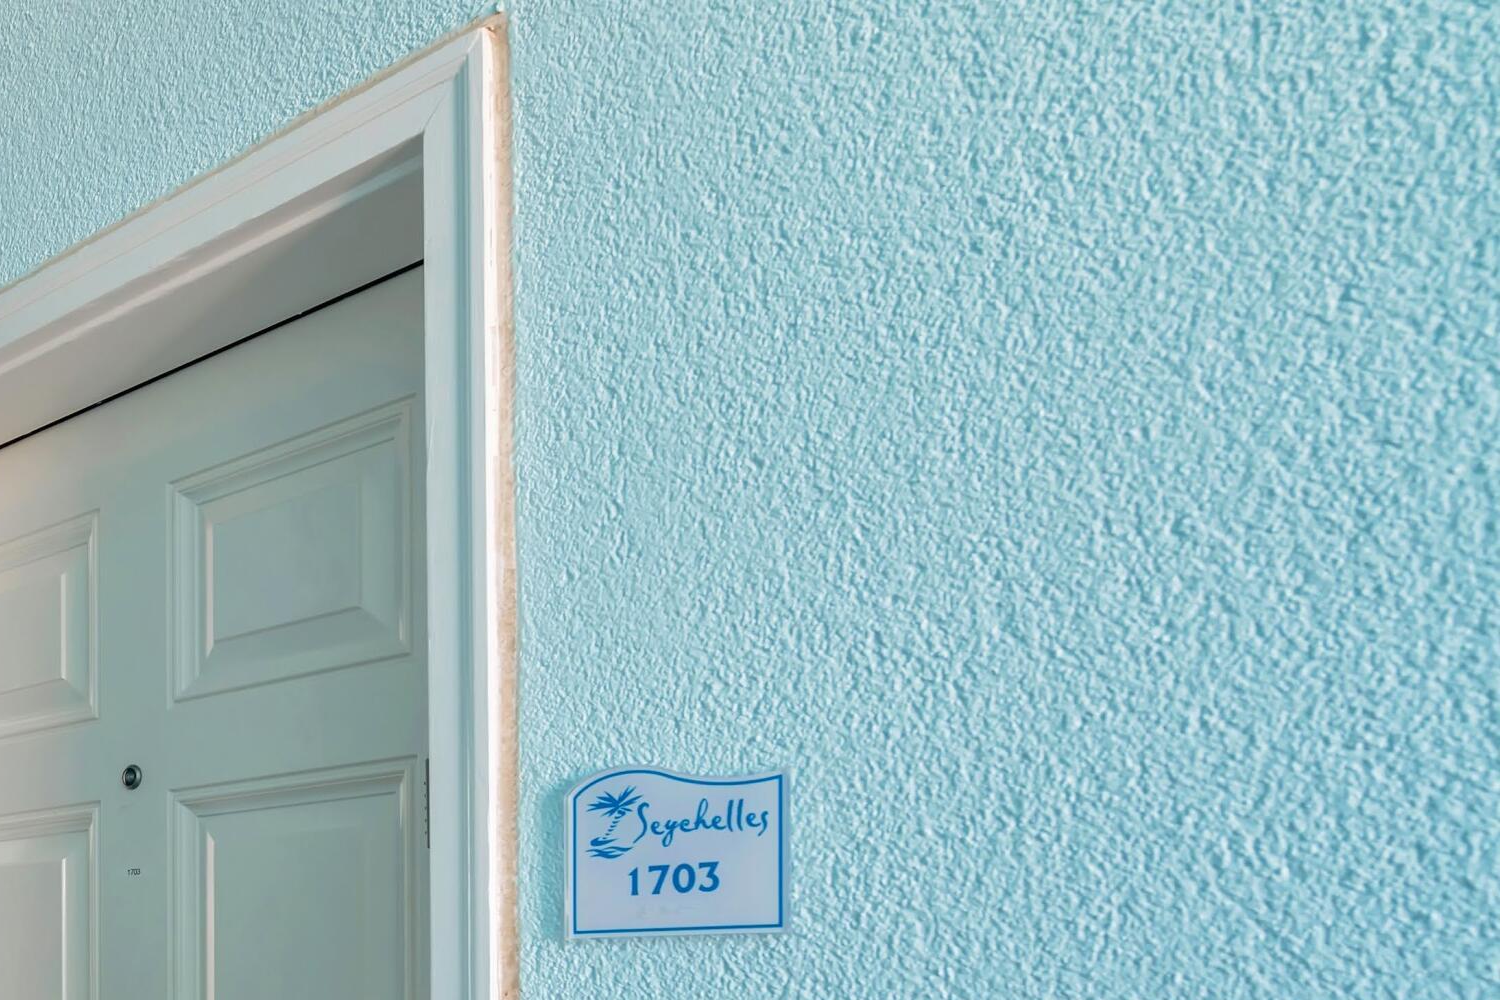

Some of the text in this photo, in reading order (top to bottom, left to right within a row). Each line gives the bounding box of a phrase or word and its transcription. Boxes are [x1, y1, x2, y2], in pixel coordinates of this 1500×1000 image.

[633, 798, 768, 847] Seychelles
[127, 868, 141, 876] 1703
[628, 861, 719, 896] 1703
